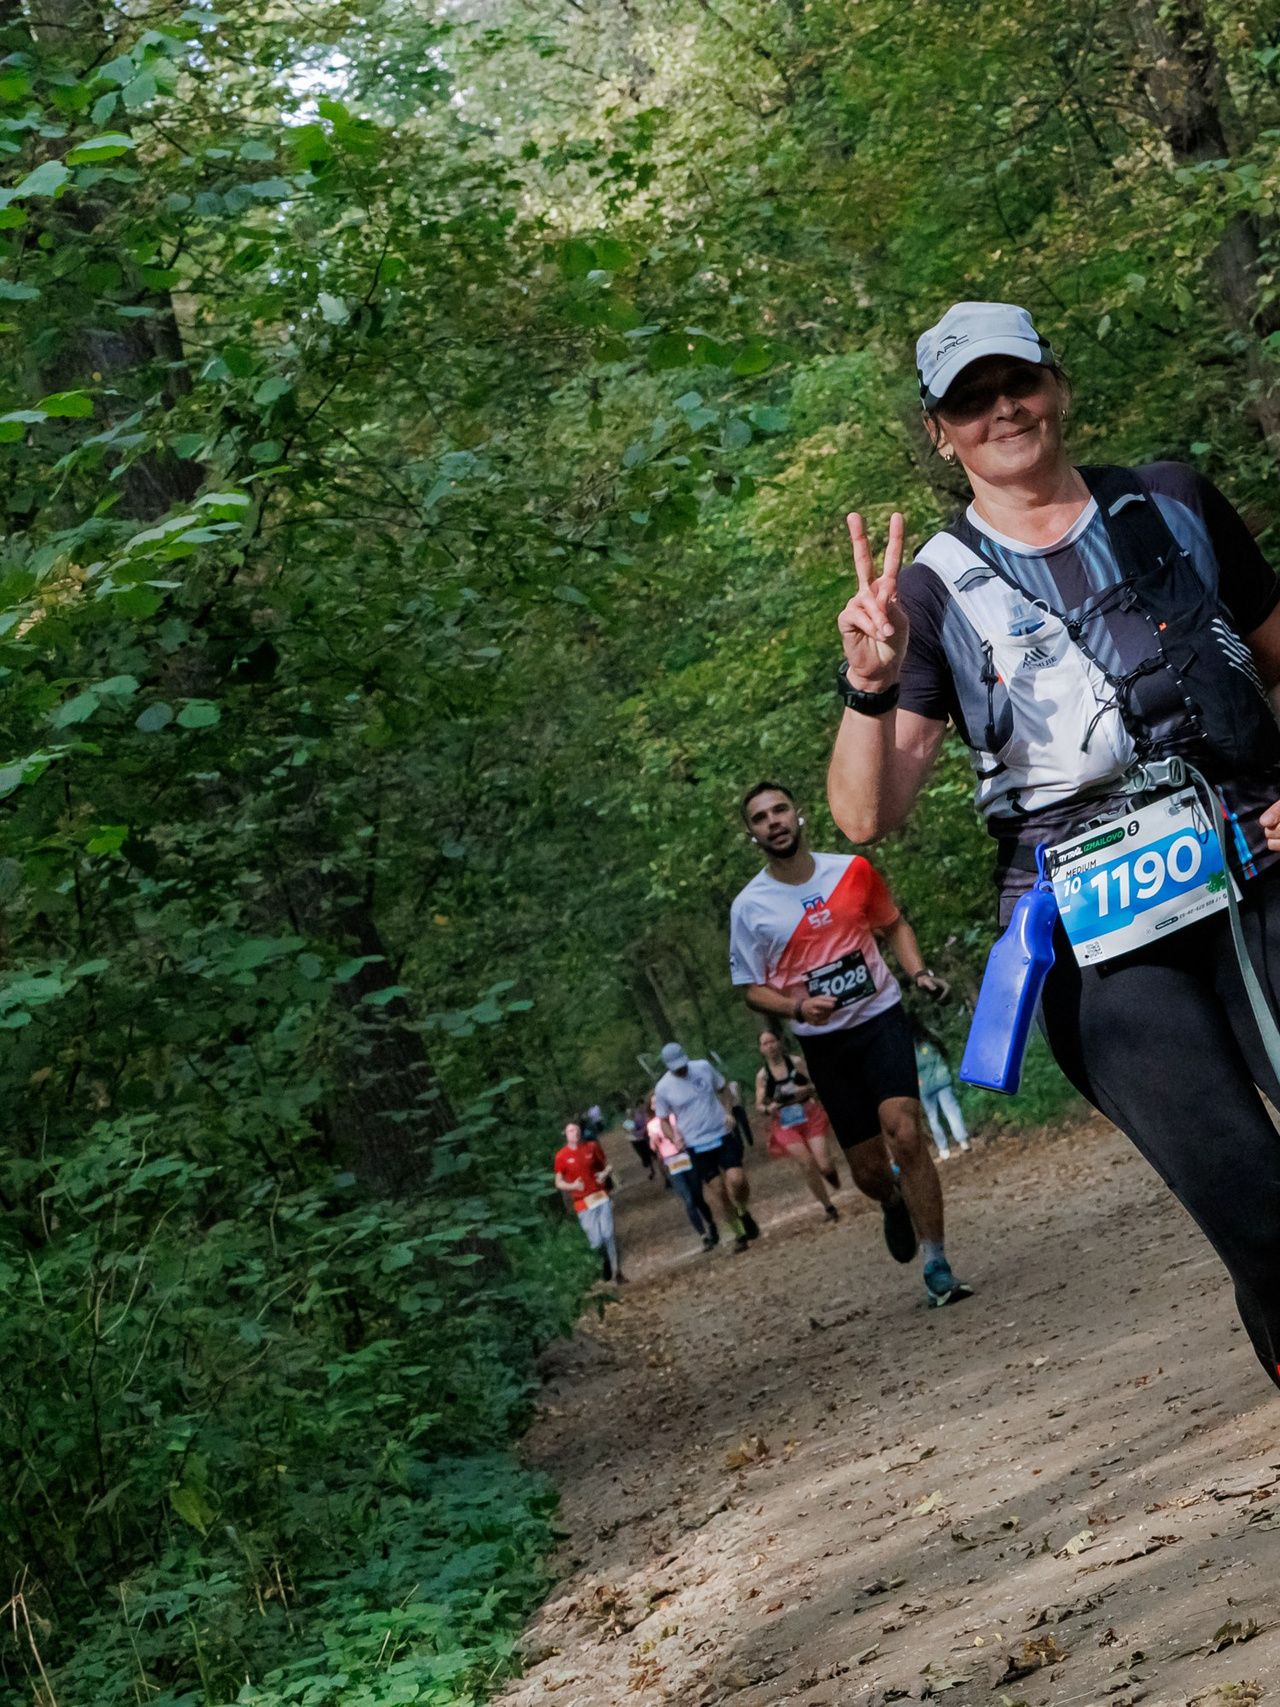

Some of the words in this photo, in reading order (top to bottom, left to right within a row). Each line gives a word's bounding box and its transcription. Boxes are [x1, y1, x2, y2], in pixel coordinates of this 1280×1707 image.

[936, 334, 969, 360] ARC
[1130, 822, 1138, 834] 5
[1083, 830, 1123, 852] IZMAILOVO
[1065, 859, 1097, 879] MEDIUM
[1089, 834, 1203, 918] 1190
[1063, 876, 1082, 897] 10
[808, 908, 833, 929] 52
[819, 964, 867, 997] 3028
